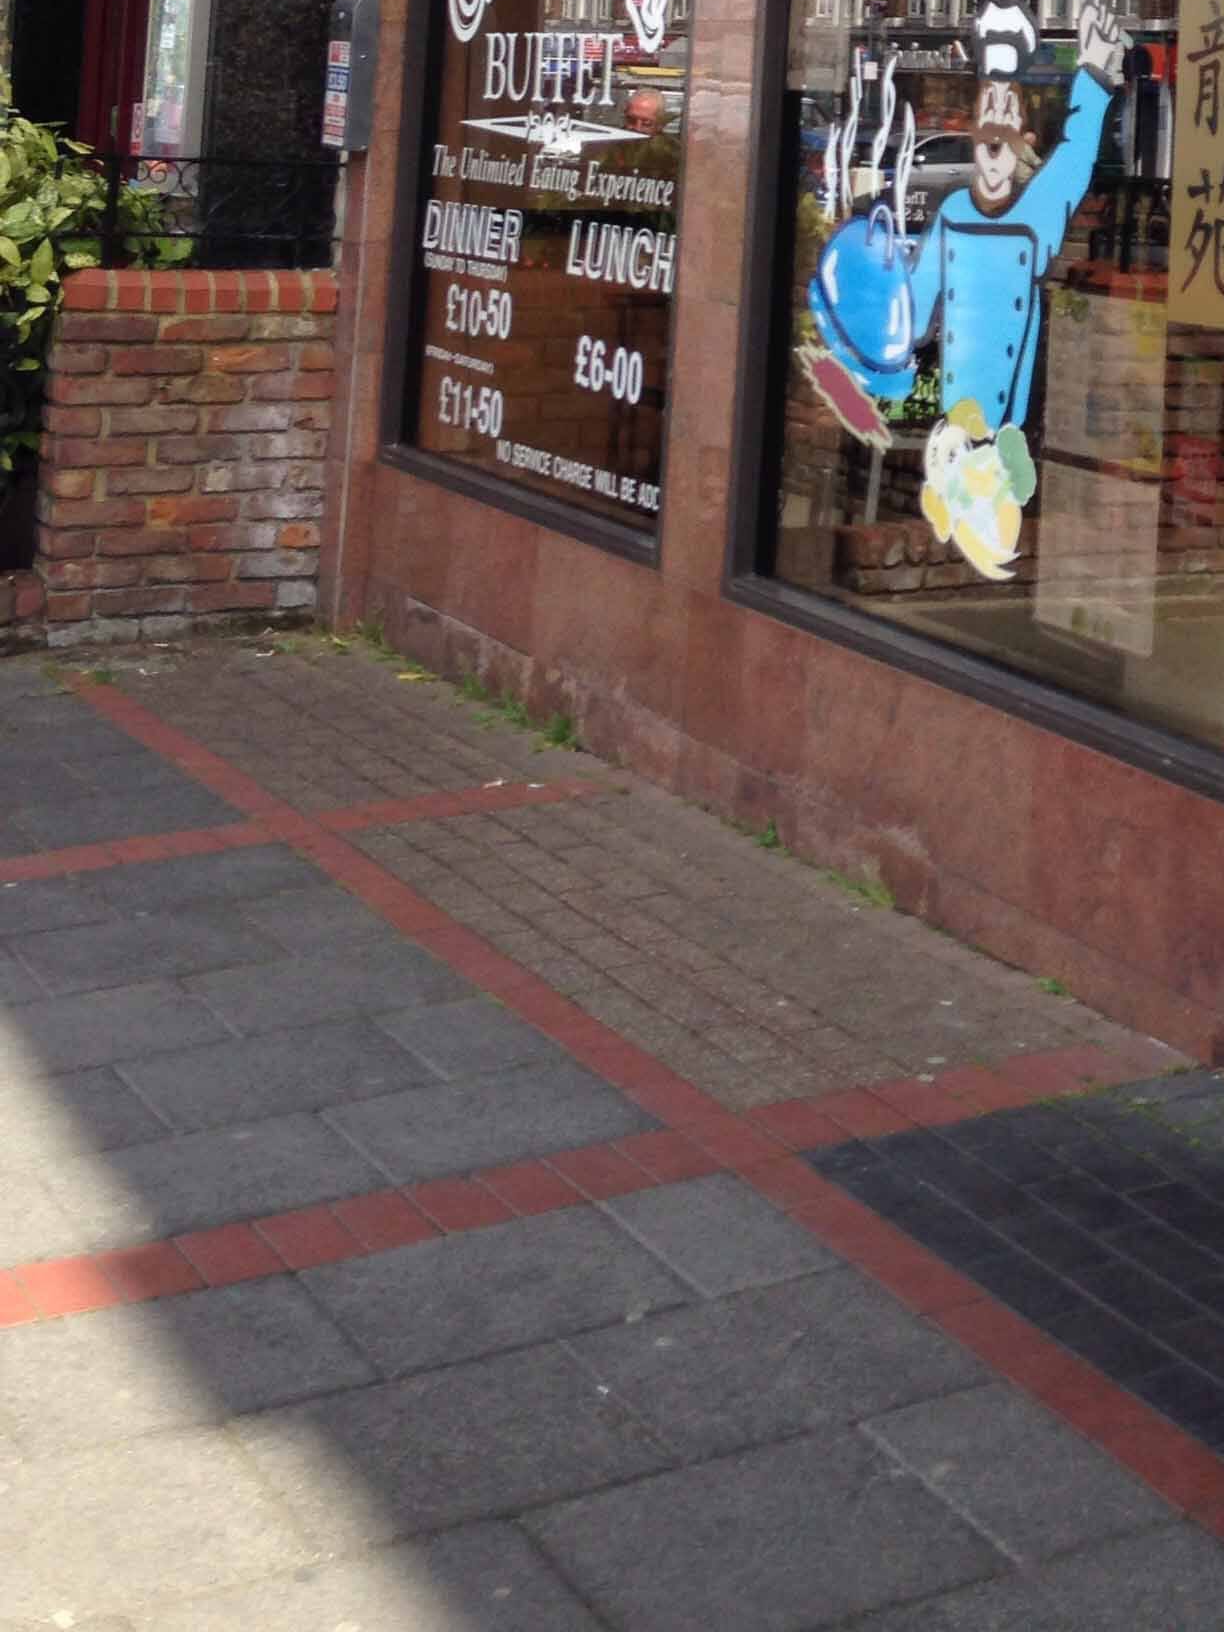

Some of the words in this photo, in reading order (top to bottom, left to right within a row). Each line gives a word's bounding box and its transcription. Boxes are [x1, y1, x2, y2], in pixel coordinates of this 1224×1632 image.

[482, 32, 623, 107] BUFFET
[432, 144, 455, 177] The
[460, 147, 527, 187] Unlimited
[529, 155, 580, 201] Eating
[584, 161, 674, 207] Experience
[422, 199, 523, 263] DINNER
[565, 219, 677, 294] LUNCH
[512, 443, 552, 475] SERVICE
[553, 456, 593, 489] CHARGE
[595, 469, 618, 498] WILL
[620, 476, 637, 503] BE
